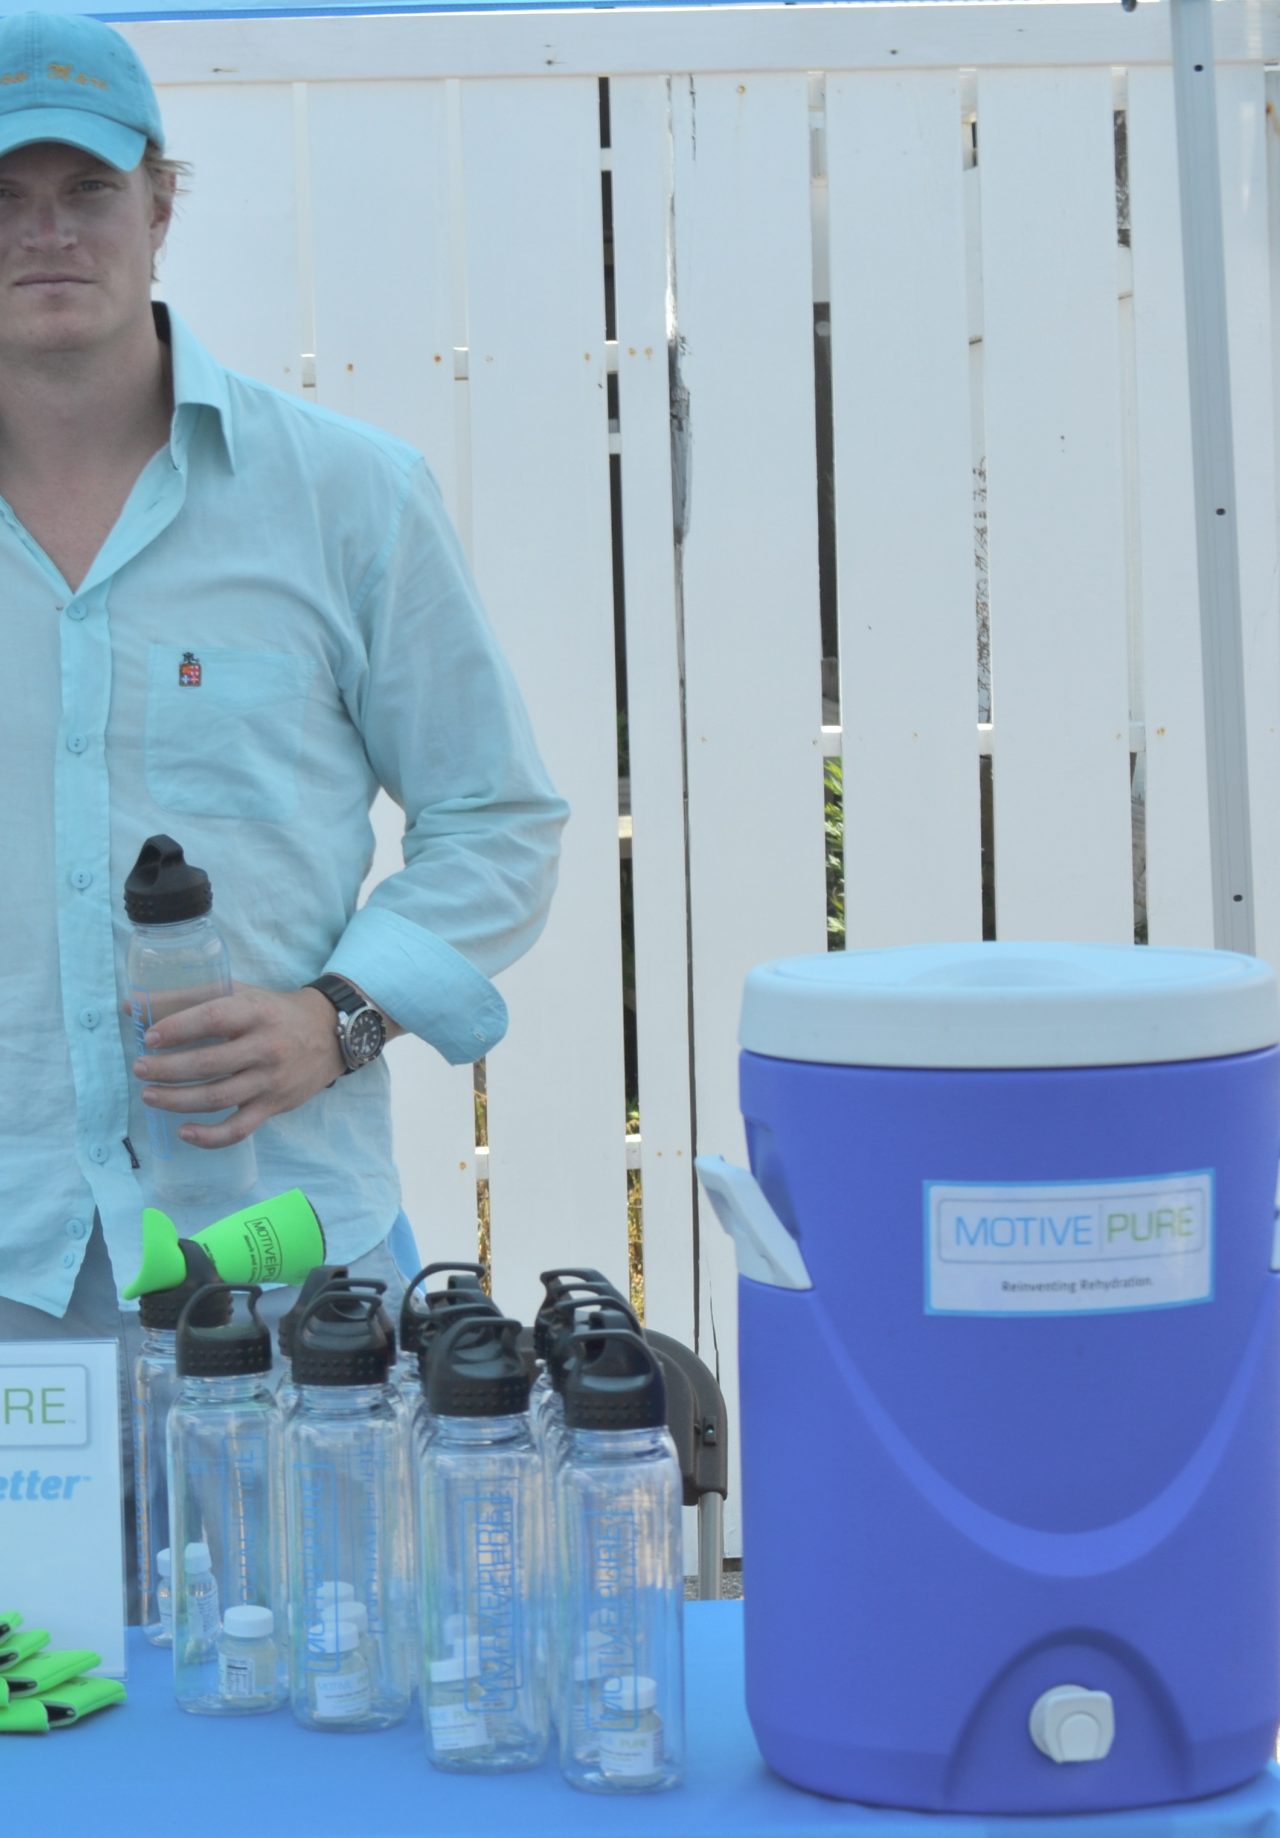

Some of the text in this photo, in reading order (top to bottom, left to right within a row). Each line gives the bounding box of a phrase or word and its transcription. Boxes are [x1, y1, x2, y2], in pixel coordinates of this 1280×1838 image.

[955, 1206, 1194, 1248] MOTIVE PURE
[1001, 1279, 1077, 1295] Reinventing
